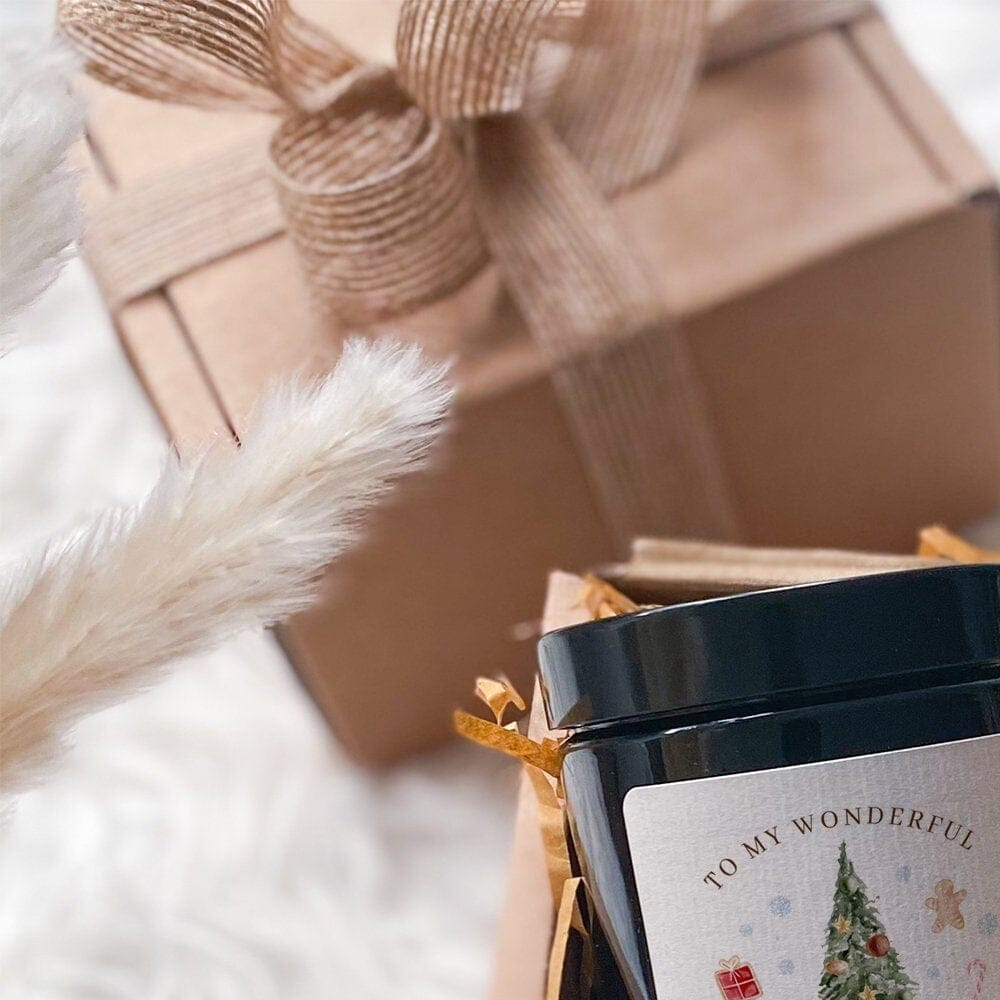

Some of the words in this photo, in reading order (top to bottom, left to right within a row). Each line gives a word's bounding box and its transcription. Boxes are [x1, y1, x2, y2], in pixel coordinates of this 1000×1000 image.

[702, 857, 738, 891] TO
[741, 826, 782, 860] MY
[792, 806, 976, 851] WONDERFUL
